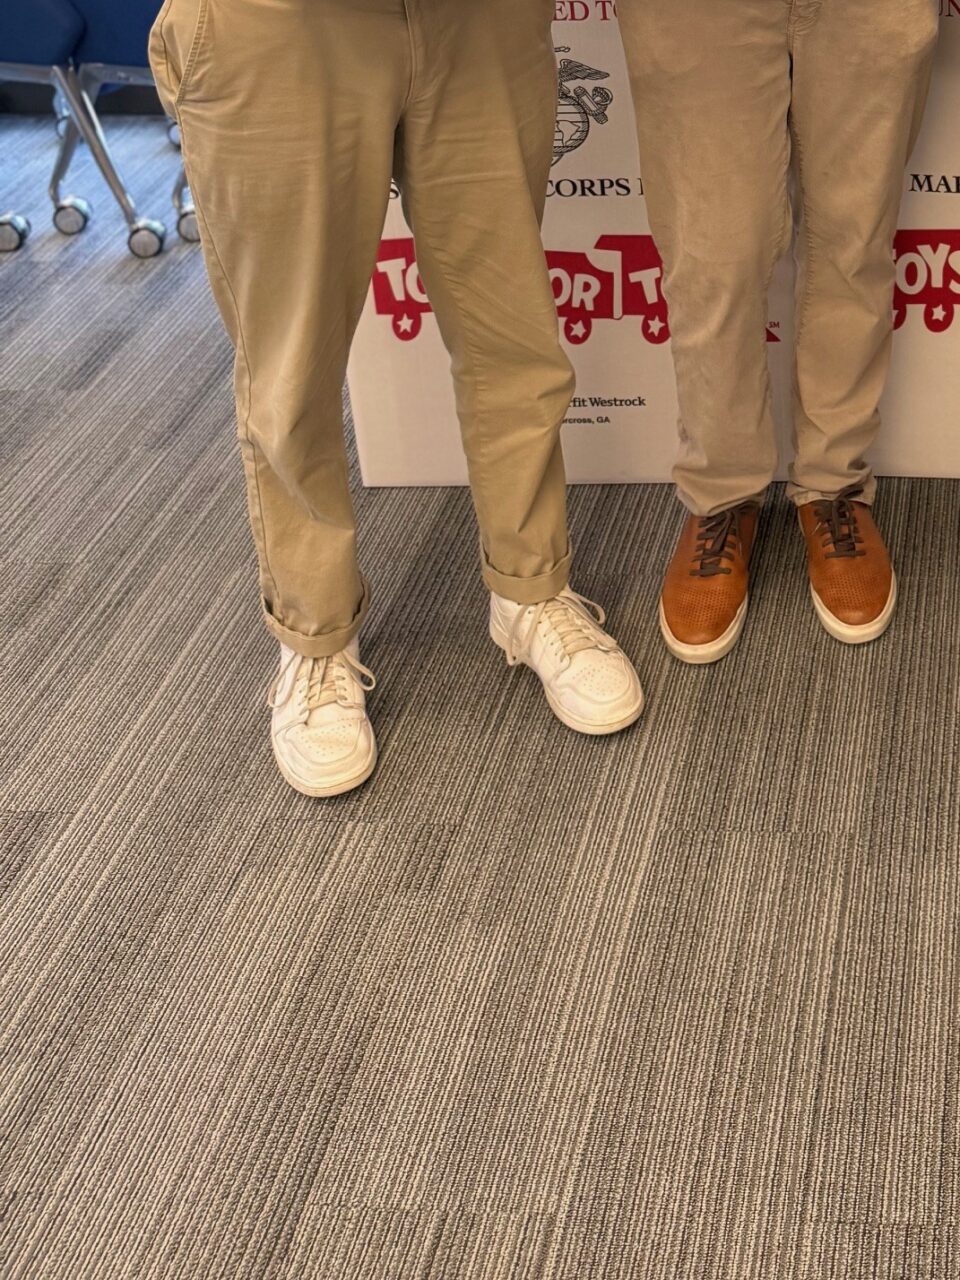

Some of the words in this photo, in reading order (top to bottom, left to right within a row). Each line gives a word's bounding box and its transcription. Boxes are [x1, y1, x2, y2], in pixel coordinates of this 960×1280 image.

[376, 257, 433, 303] TO
[550, 268, 601, 311] OR
[588, 396, 647, 407] Westrock
[596, 416, 611, 424] GA
